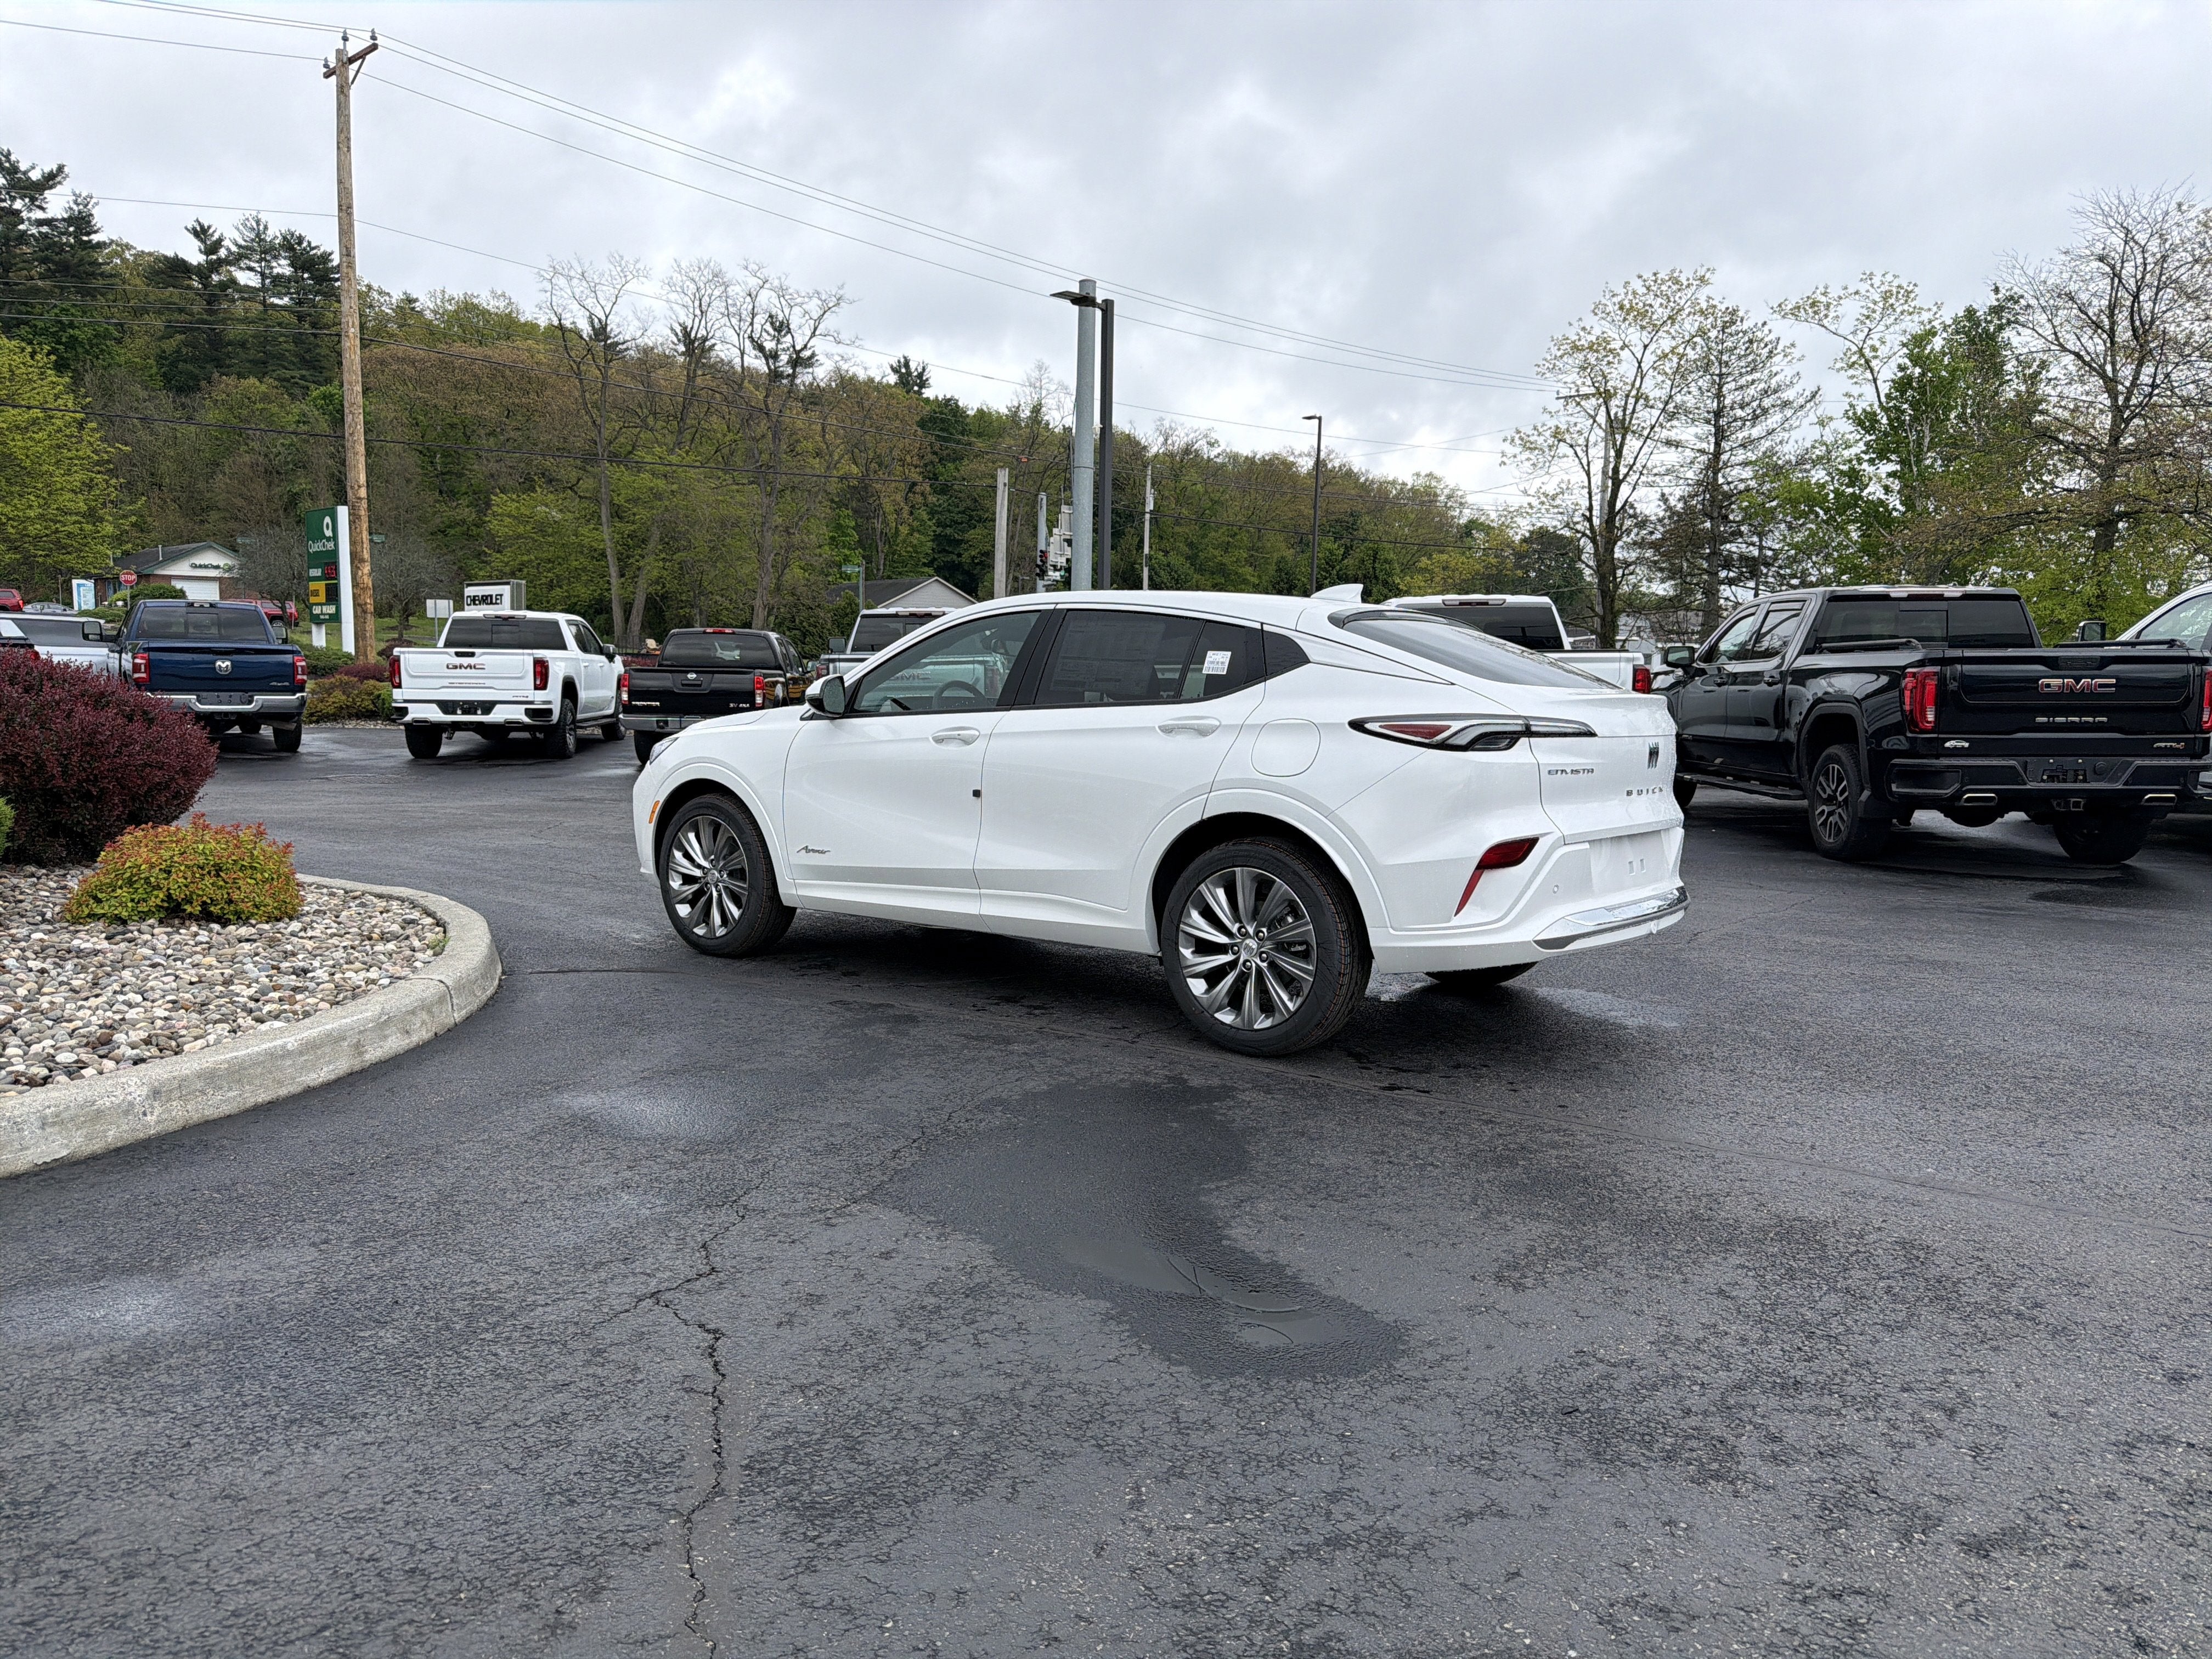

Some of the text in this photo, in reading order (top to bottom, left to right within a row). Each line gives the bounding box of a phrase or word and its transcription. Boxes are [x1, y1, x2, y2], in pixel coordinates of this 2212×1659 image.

[308, 538, 335, 554] QuickChek
[466, 594, 504, 606] CHEVROLET
[312, 605, 336, 614] CAR WASH
[2039, 679, 2116, 693] GMC
[1626, 786, 1663, 796] BUICK
